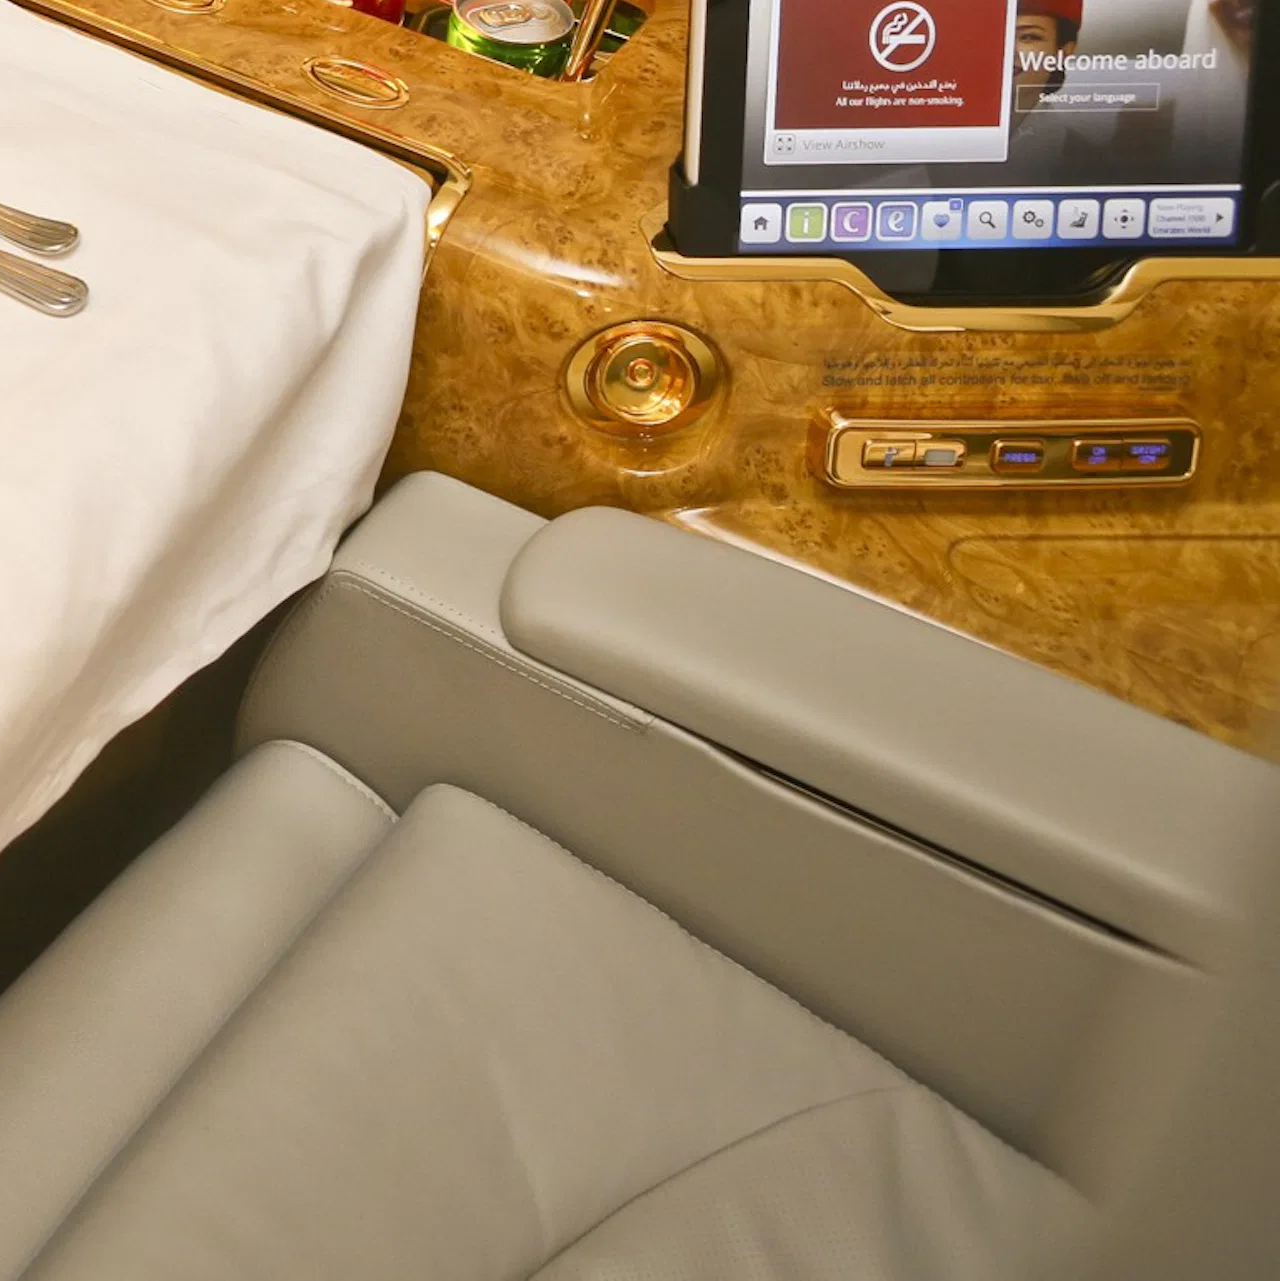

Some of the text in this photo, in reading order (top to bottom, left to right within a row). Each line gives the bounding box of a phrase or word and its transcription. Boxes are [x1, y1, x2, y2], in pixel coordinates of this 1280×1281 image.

[1019, 47, 1218, 71] Welcome aboard
[836, 96, 964, 109] All our flights are non-smoking.
[1039, 92, 1136, 104] Select your language
[802, 138, 886, 151] View Airshow
[823, 374, 852, 387] Stow
[856, 375, 882, 386] and
[885, 374, 917, 386] latch
[919, 374, 936, 386] all
